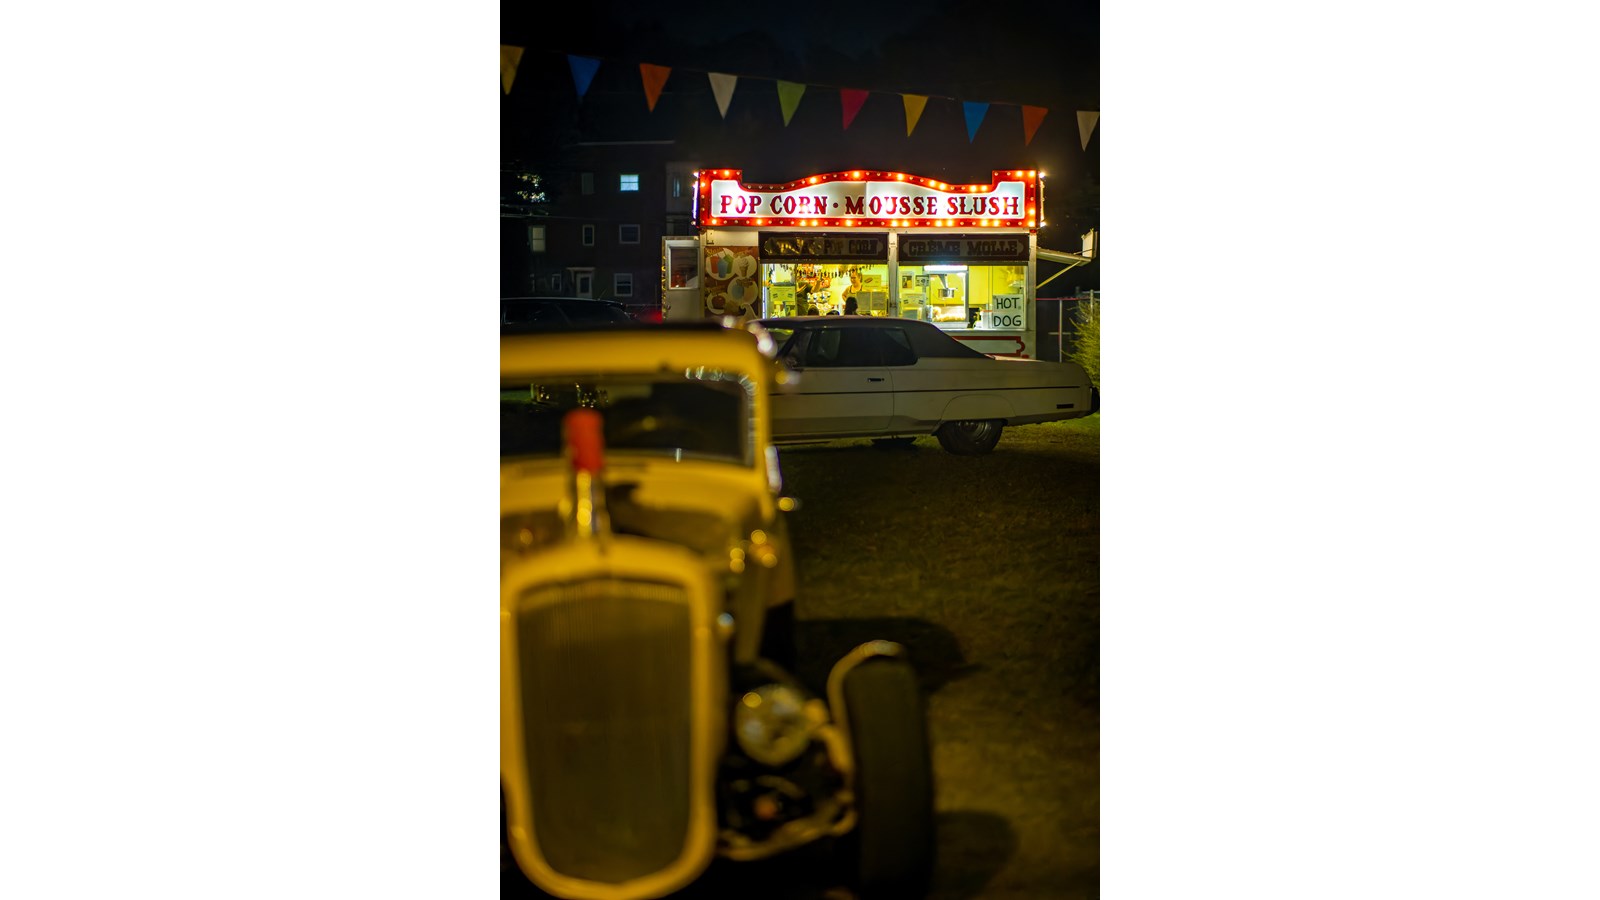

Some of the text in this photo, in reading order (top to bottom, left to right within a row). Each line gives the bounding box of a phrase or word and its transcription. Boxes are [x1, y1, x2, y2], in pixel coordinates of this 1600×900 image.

[720, 195, 1019, 215] POP CORN MOUSSE SLUSH
[966, 240, 1018, 256] MOLLE
[996, 297, 1020, 310] HOT
[993, 315, 1022, 327] DOG
